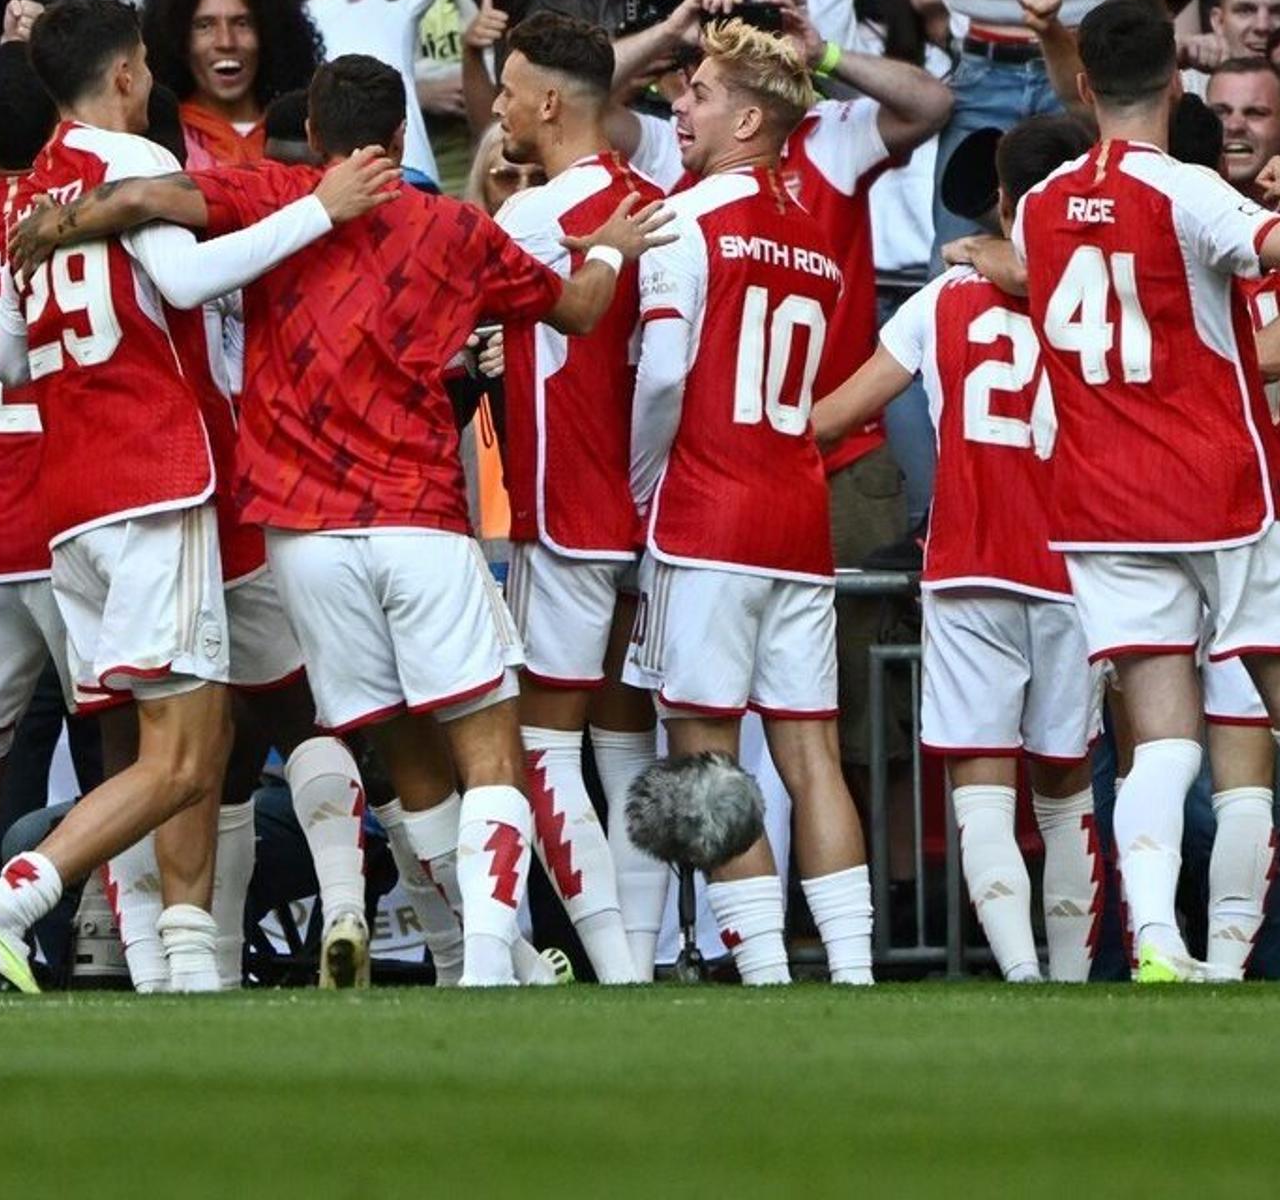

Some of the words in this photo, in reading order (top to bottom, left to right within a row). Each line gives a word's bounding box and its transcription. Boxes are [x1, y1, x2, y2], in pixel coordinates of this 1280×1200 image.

[720, 235, 789, 268] SMITH
[1044, 244, 1152, 386] 41
[733, 285, 827, 437] 10
